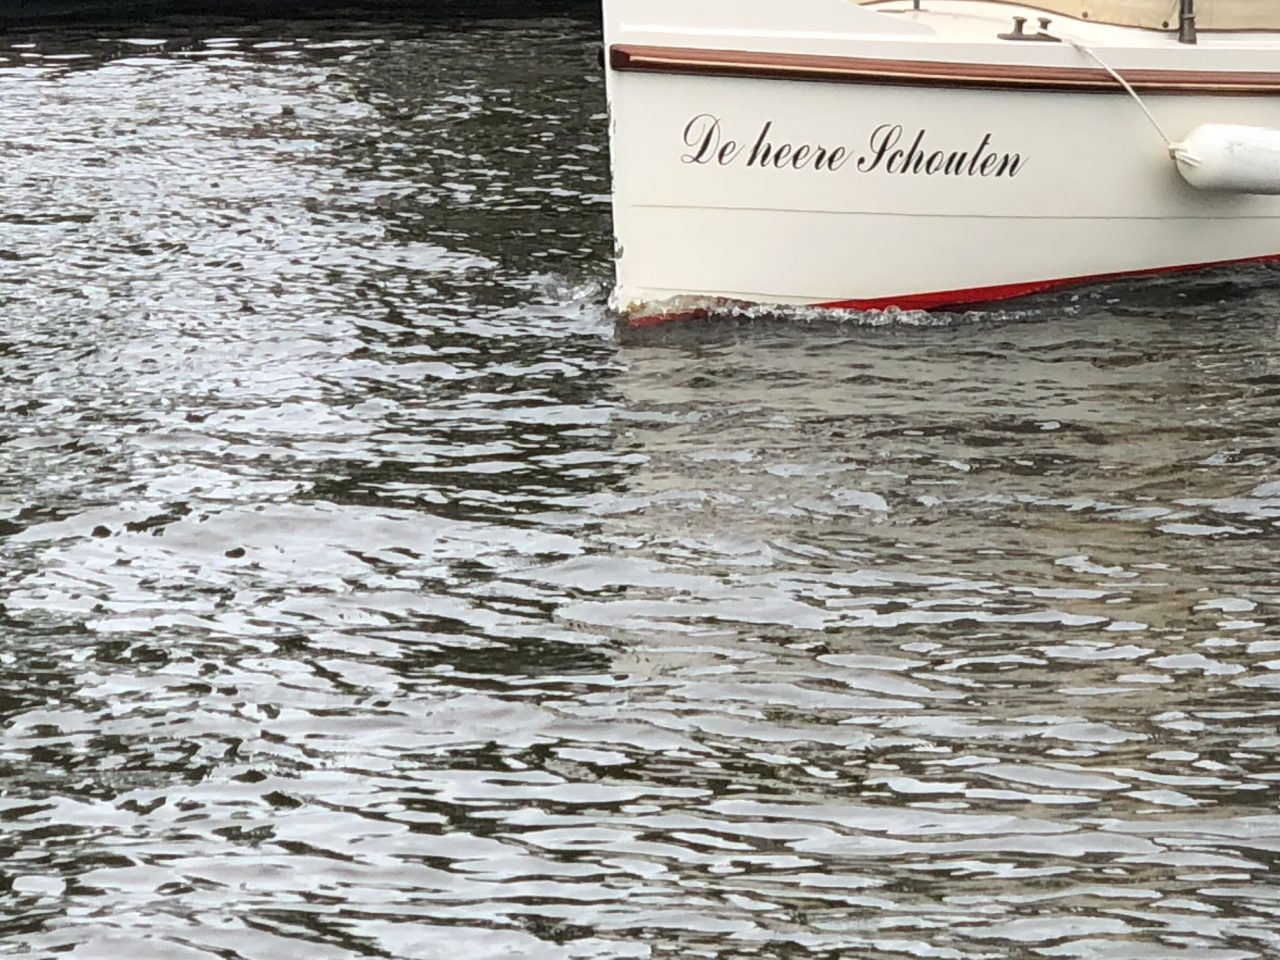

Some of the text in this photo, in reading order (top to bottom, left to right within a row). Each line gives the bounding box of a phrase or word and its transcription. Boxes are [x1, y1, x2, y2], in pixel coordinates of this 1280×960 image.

[681, 113, 1028, 177] De heere Schouten
